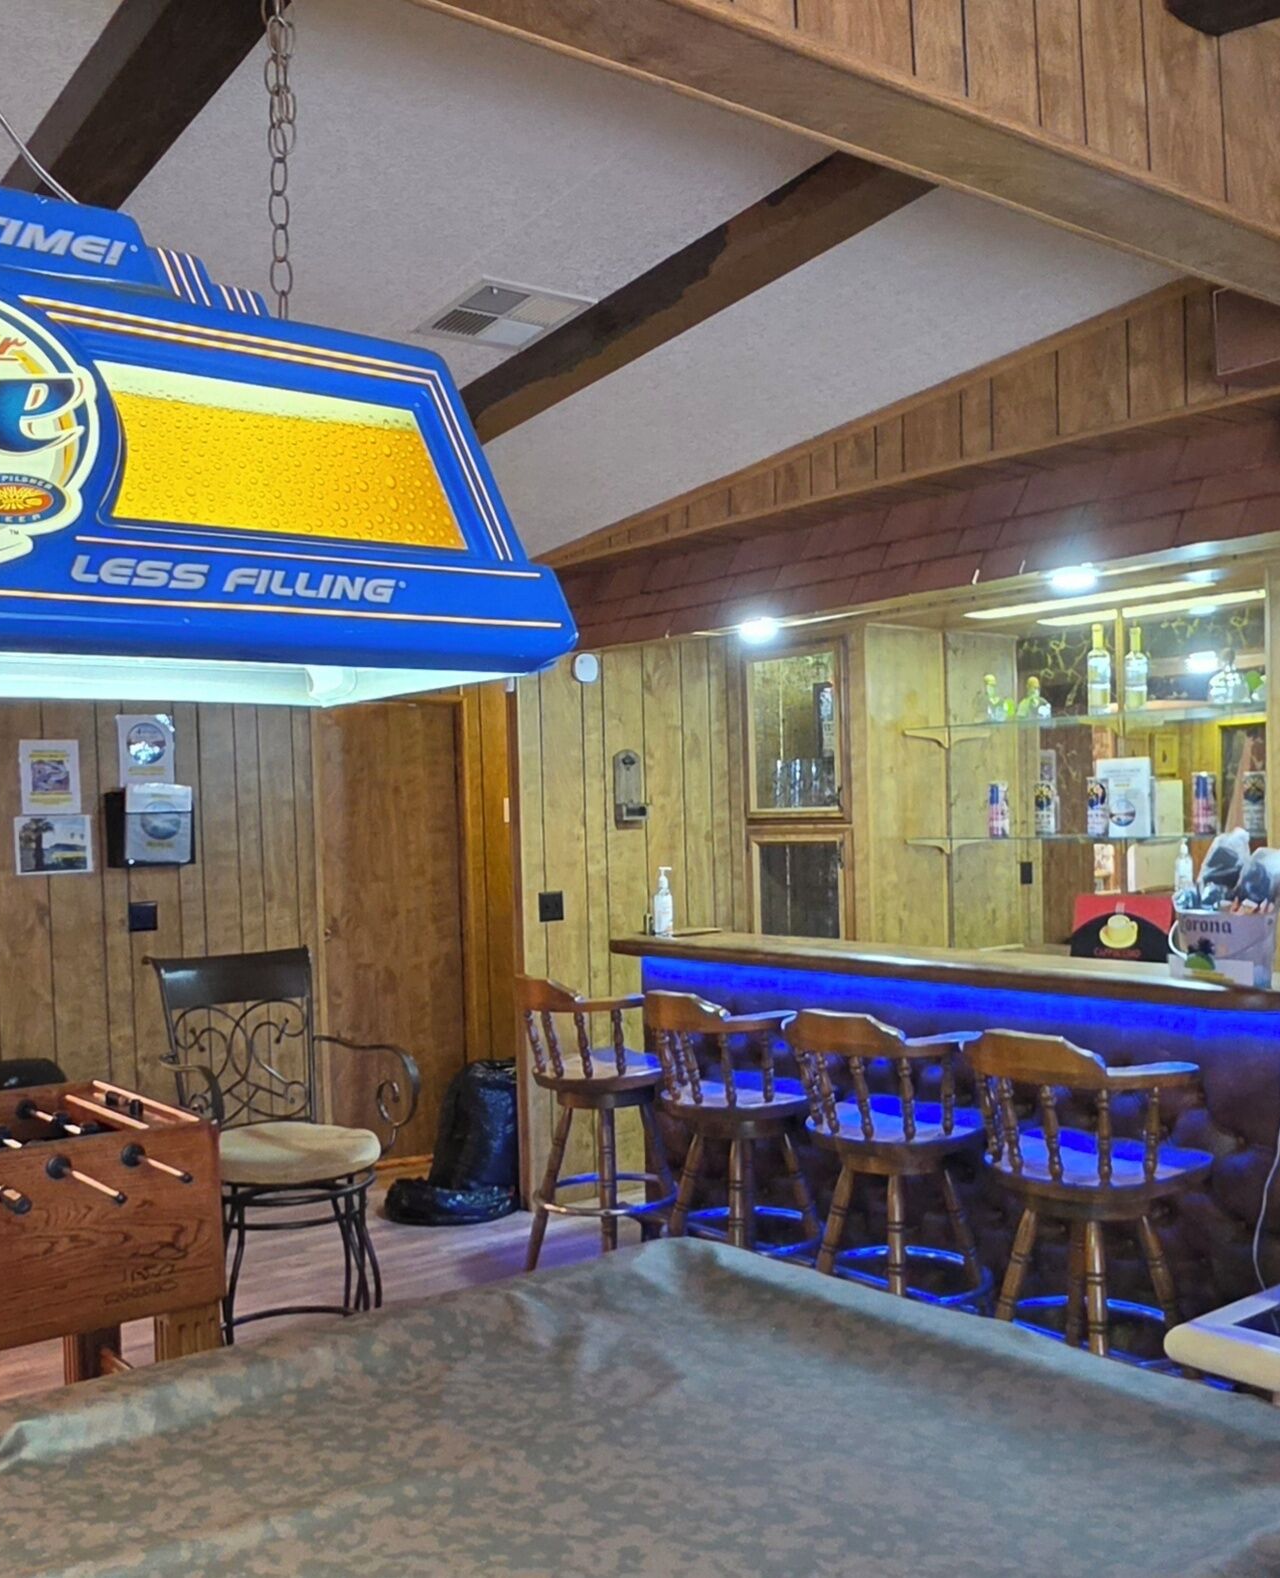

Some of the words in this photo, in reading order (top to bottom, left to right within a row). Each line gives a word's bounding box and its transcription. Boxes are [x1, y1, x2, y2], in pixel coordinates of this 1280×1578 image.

[1, 474, 54, 491] PILSNER
[70, 554, 210, 590] LESS
[222, 567, 397, 604] FILLING
